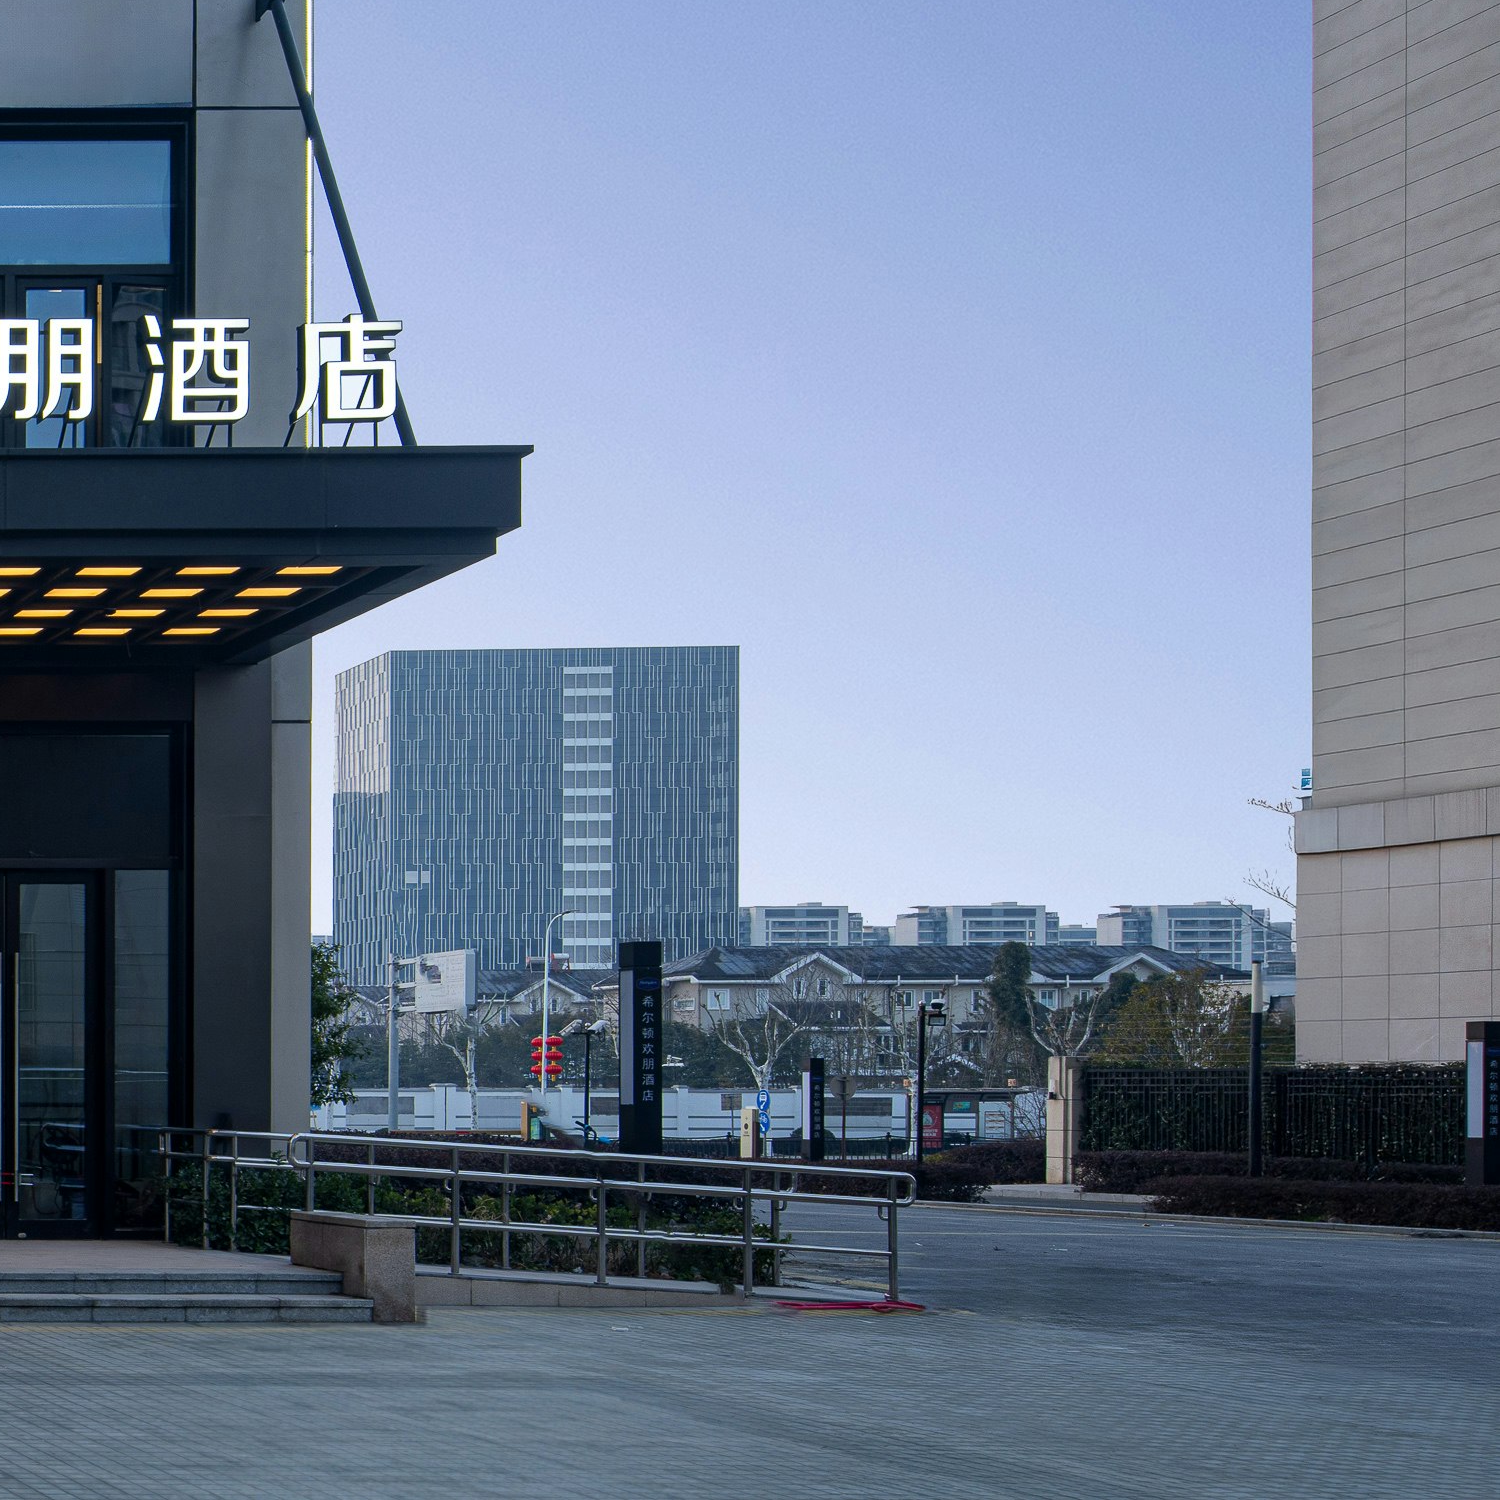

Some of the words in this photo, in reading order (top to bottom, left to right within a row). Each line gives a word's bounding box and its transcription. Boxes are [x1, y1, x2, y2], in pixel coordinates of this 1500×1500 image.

[642, 996, 655, 1101] 希尔顿欢朋酒店
